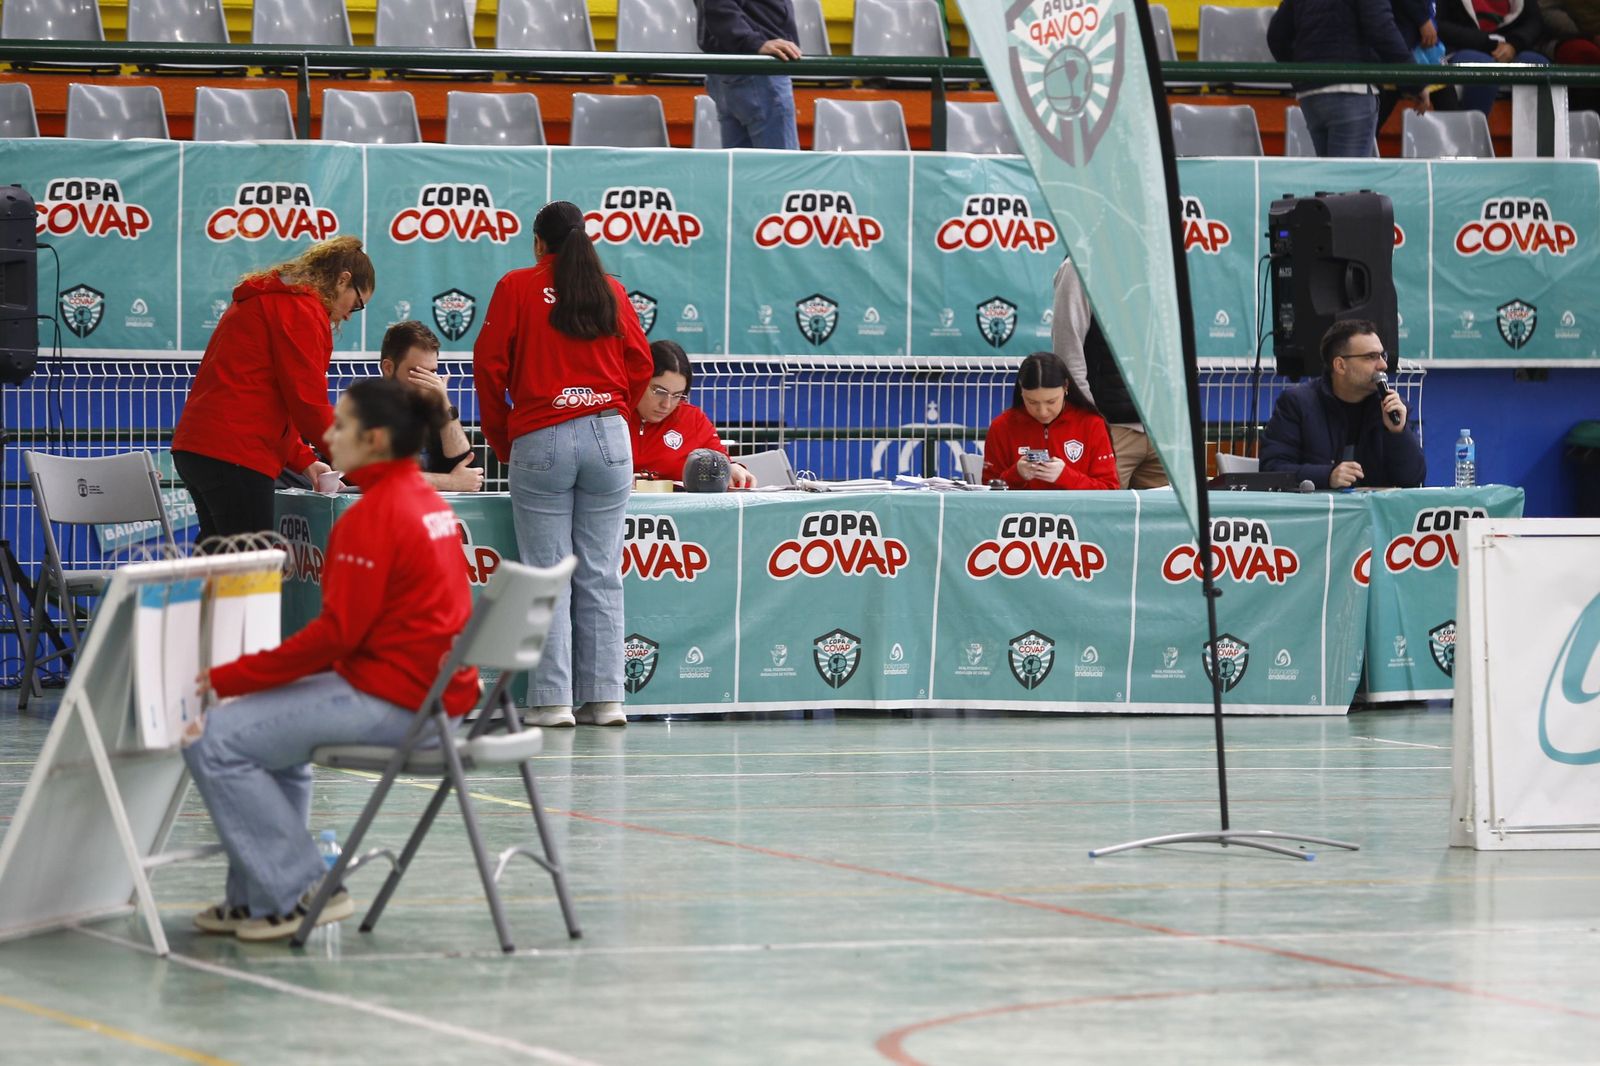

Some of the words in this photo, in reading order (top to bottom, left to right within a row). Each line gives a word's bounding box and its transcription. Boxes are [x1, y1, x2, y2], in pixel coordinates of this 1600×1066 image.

[48, 181, 120, 203] COPA
[239, 185, 311, 207] COPA
[422, 186, 490, 207] COPA
[605, 190, 672, 211] COPA
[785, 193, 852, 214] COPA
[966, 198, 1028, 217] COPA
[1484, 201, 1549, 221] COPA
[207, 207, 337, 240] COVAP
[391, 207, 519, 241] COVAP
[583, 211, 700, 245] COVAP
[755, 213, 881, 248] COVAP
[937, 218, 1056, 251] COVAP
[1456, 222, 1575, 254] COVAP
[281, 518, 310, 544] COPA
[624, 518, 676, 541] OPA
[802, 514, 878, 538] COPA
[1001, 516, 1075, 541] COPA
[1208, 520, 1269, 545] OPA
[621, 542, 708, 579] VAP
[769, 539, 908, 578] COVAP
[967, 540, 1105, 579] COVAP
[1163, 544, 1298, 583] COVAP
[1385, 533, 1460, 571] COV
[824, 644, 851, 652] COVAP
[1018, 645, 1045, 653] COVAP
[1438, 635, 1456, 643] COV
